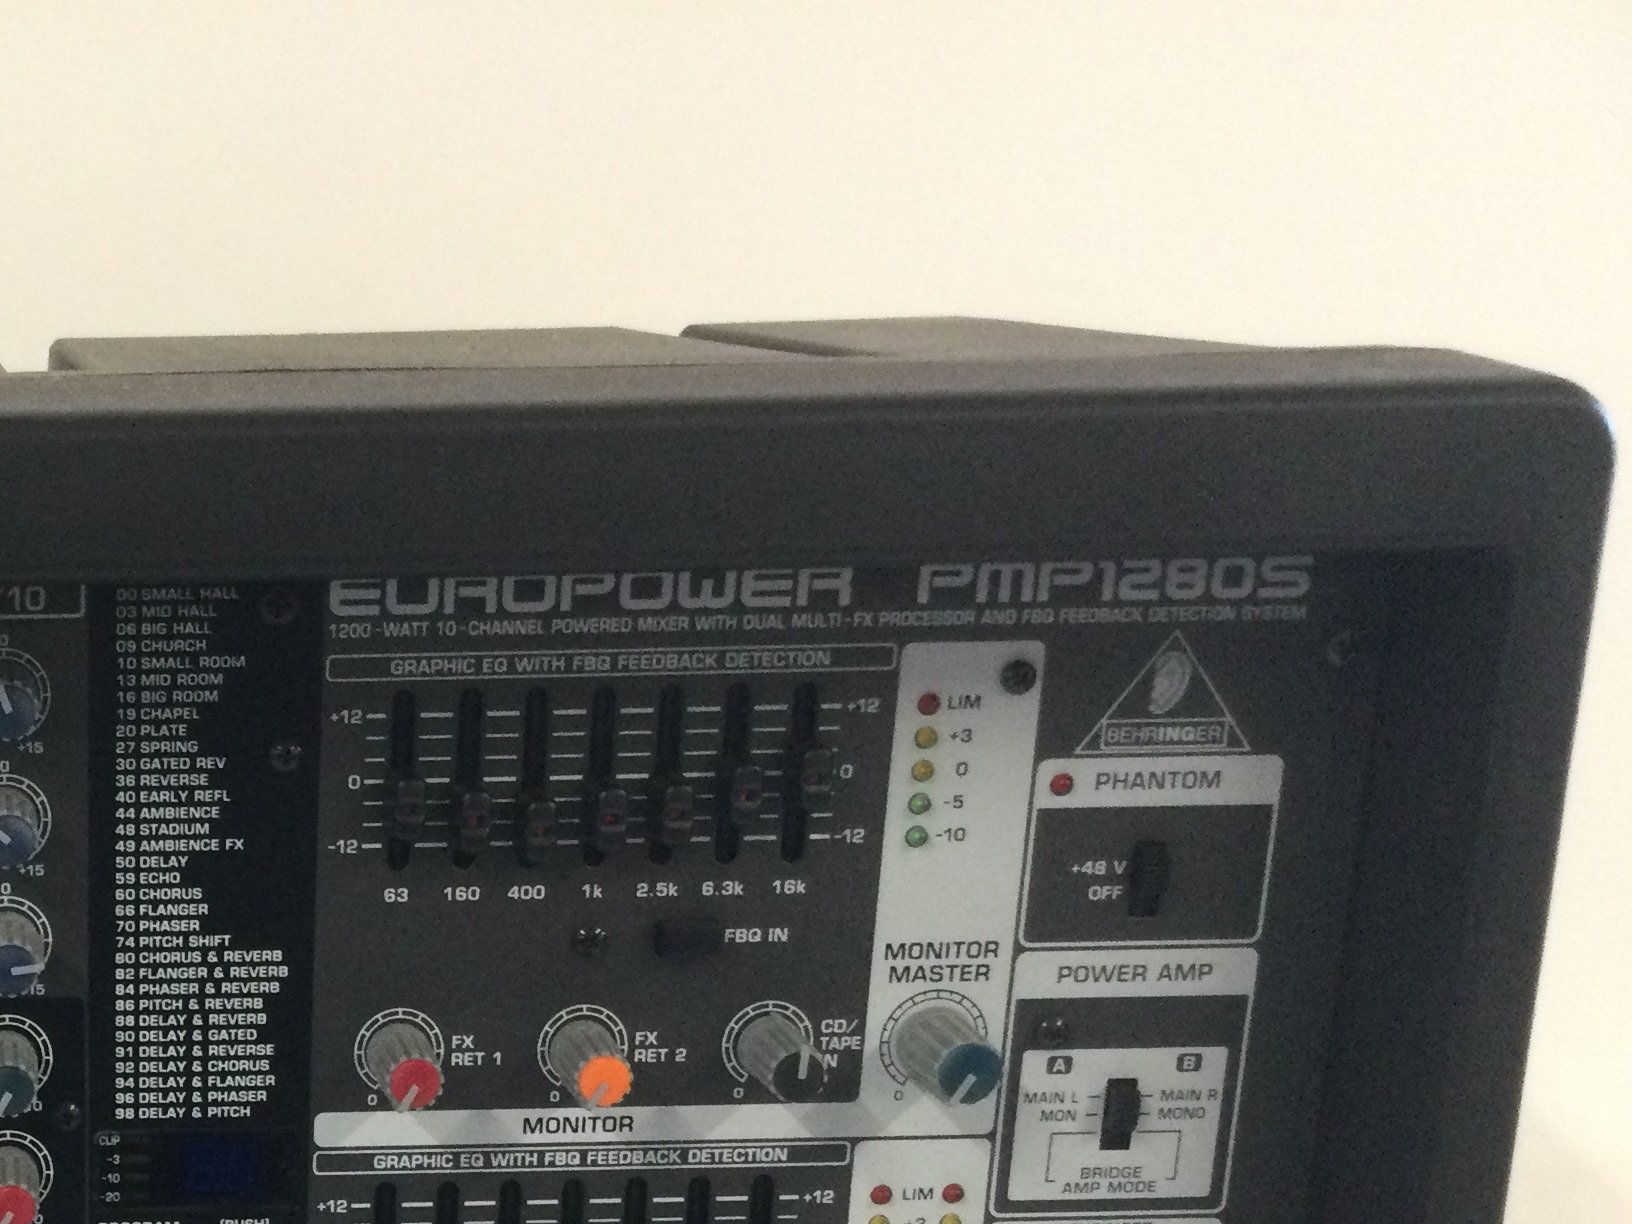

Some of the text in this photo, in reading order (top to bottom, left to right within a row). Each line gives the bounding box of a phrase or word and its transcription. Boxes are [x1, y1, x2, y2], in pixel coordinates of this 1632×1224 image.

[330, 556, 1314, 617] EUROPOWER PMP1280S
[552, 616, 632, 634] POWERED
[637, 615, 689, 632] MIXER
[694, 614, 737, 631] WITH
[743, 613, 786, 630] DUAL
[982, 608, 1017, 625] AND
[1022, 607, 1054, 624] FBQ
[1060, 606, 1143, 623] FEEDBACK
[117, 655, 245, 669] 10 SMALL ROOM
[390, 650, 831, 675] GRAPHIC EQ WITH FBQ FEEDBACK DETECTION
[1107, 727, 1224, 743] BEHRINGER
[1094, 770, 1222, 791] PHANTOM
[115, 790, 231, 803] 40 EARLY REFL
[115, 856, 188, 868] 50 DELAY
[115, 888, 202, 900] 60 CHORUS
[383, 887, 409, 902] 63
[444, 886, 480, 902] 160
[507, 884, 545, 900] 400
[582, 883, 602, 900] 1k
[636, 882, 678, 899] 2.5k
[702, 880, 743, 897] 6.3k
[773, 879, 806, 895] 16k
[1087, 886, 1124, 901] OFF
[115, 904, 208, 916] 66 FLANGER
[116, 935, 230, 948] 74 PITCH SHIFT
[724, 927, 788, 943] FBQ IN
[115, 950, 282, 964] 80 CHORUS & REVERB
[884, 941, 999, 960] MONITOR
[888, 964, 991, 984] MASTER
[1056, 963, 1214, 984] POWER AMP
[451, 1035, 474, 1049] FX
[451, 1051, 501, 1066] RET 1
[115, 1106, 250, 1119] 98 DELAY & PITCH
[1040, 1109, 1077, 1122] MON
[1158, 1107, 1206, 1120] MONO
[522, 1115, 634, 1135] MONITOR
[374, 1147, 788, 1169] GRAPHIC EQ WITH FBQ FEEDBACK DETECTION
[1080, 1166, 1143, 1179] BRIDGE
[902, 1187, 934, 1200] LIM
[1062, 1180, 1156, 1195] AMP MODE
